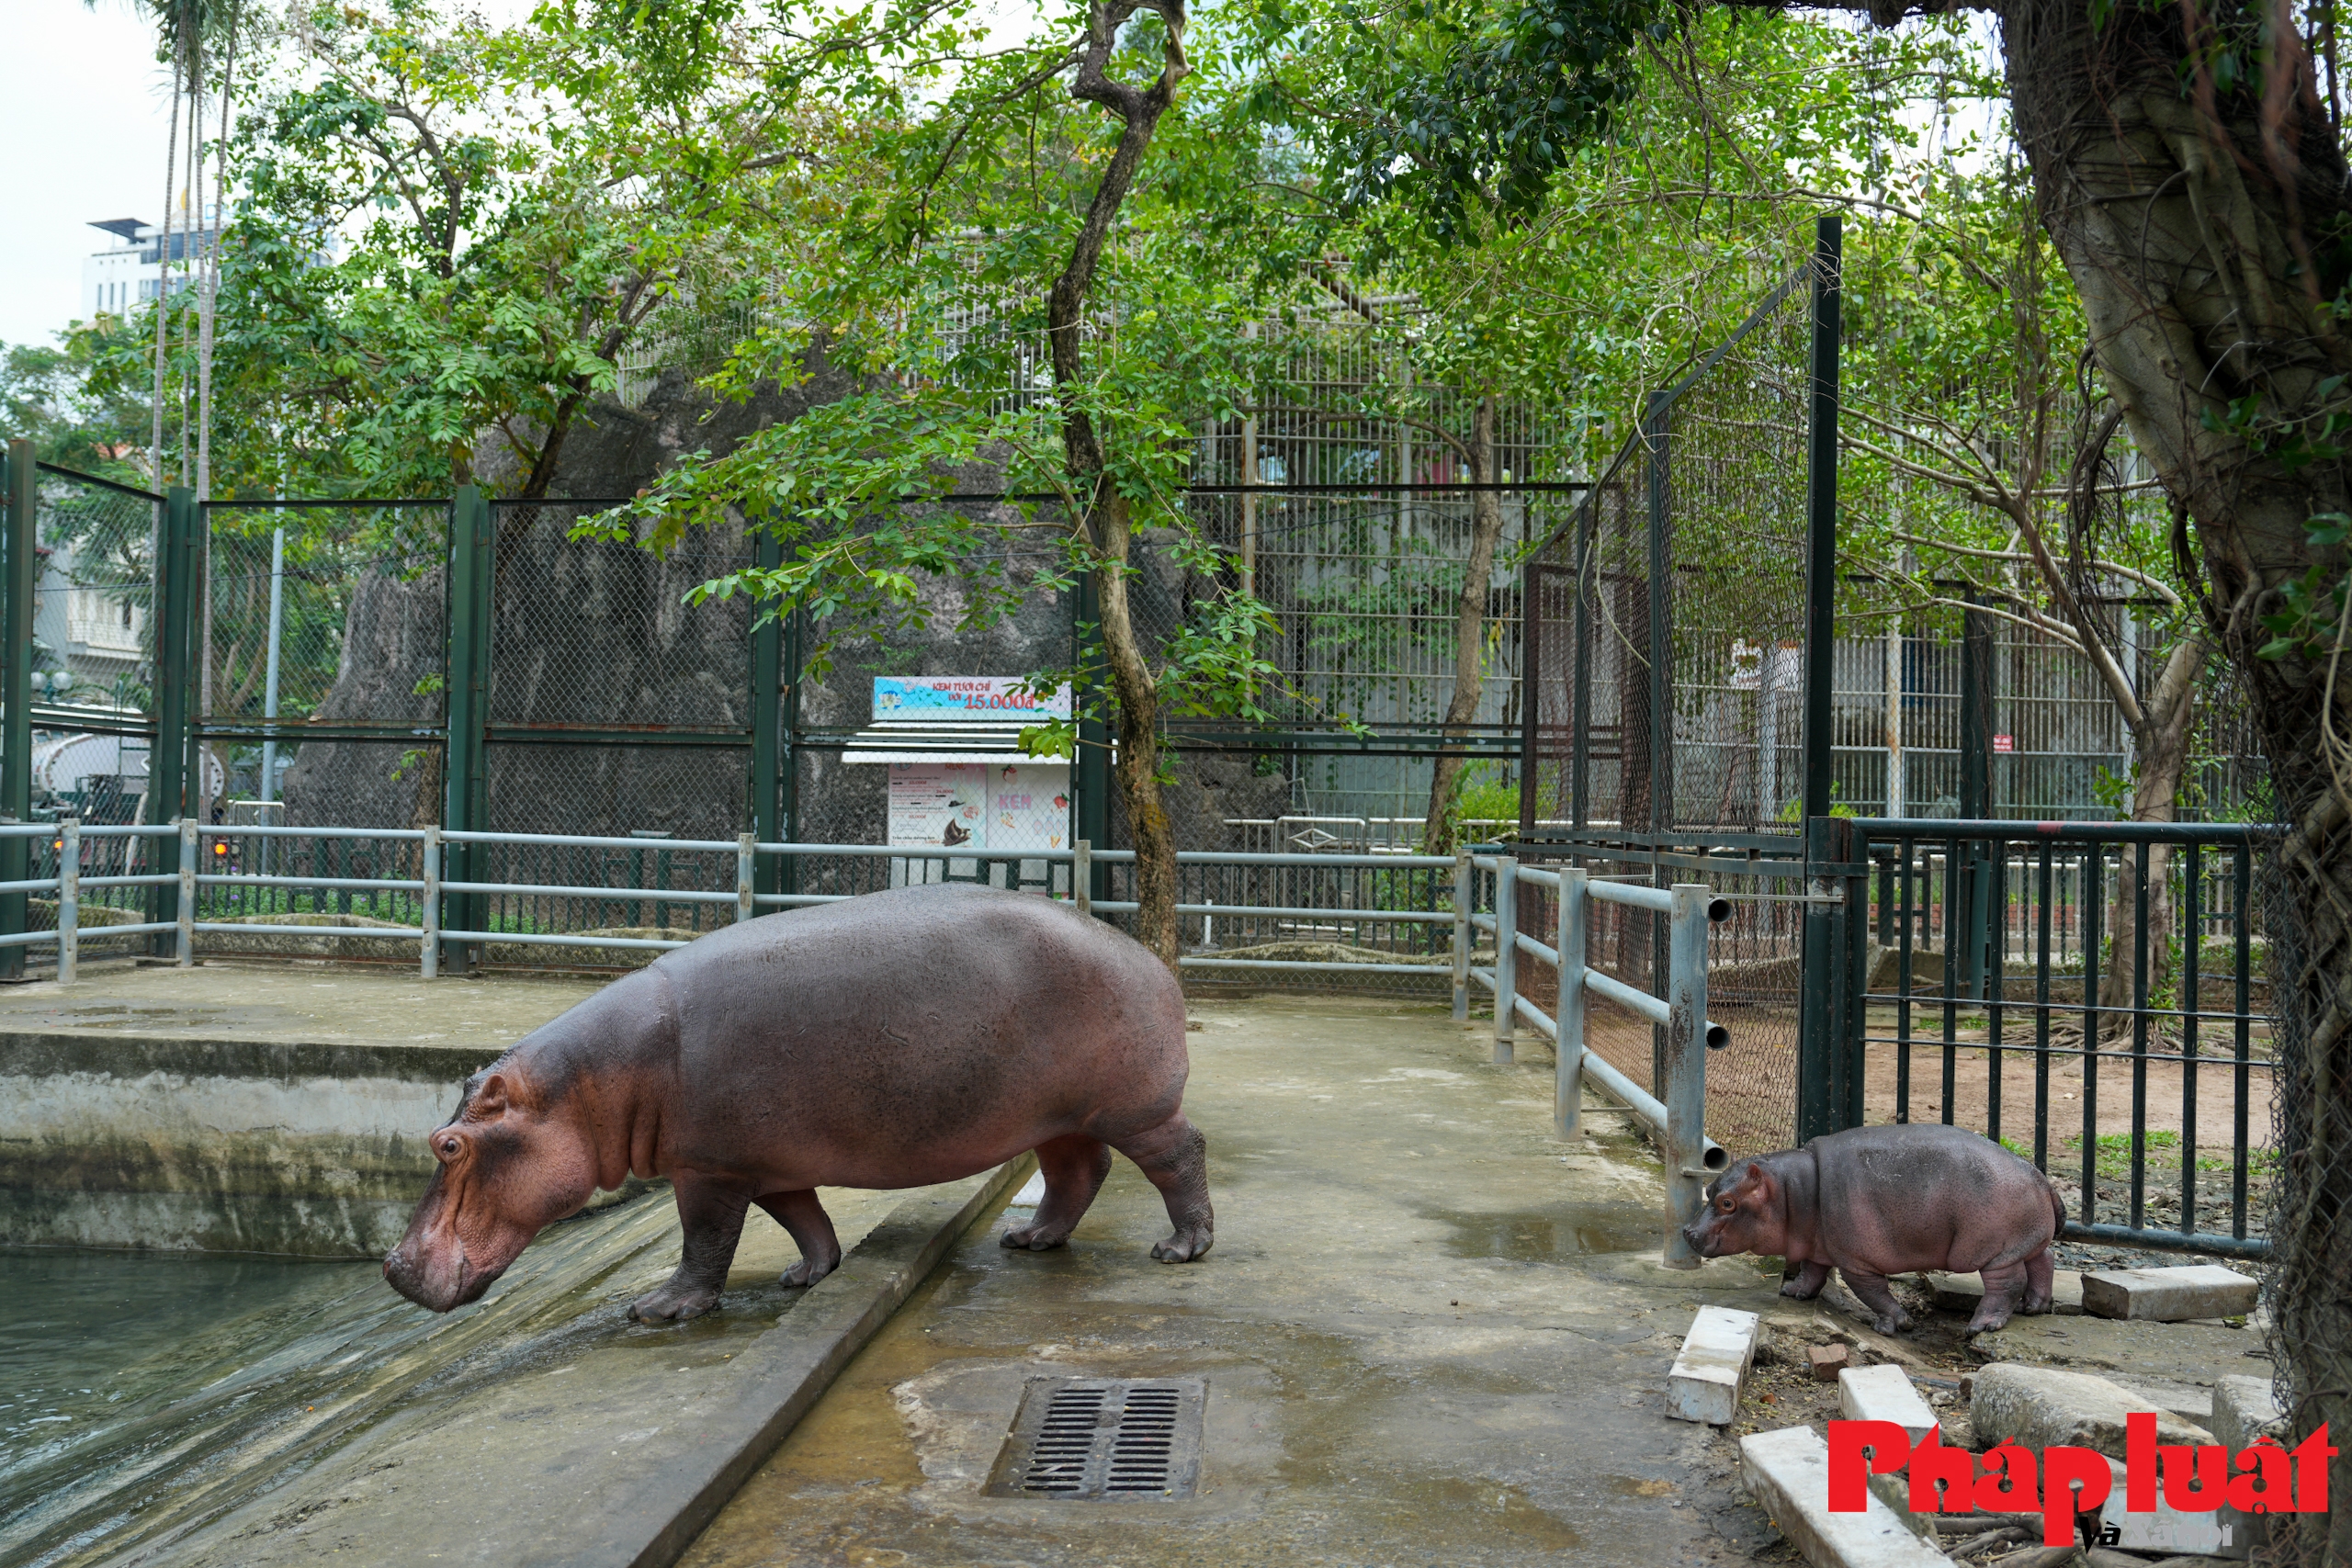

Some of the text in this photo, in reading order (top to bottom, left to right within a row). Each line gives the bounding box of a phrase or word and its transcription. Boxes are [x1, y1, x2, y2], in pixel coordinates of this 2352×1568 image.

[933, 680, 991, 692] KEM TƯƠI CHỈ
[964, 693, 1035, 710] 15.000đ
[999, 794, 1032, 810] KEM
[1033, 815, 1068, 835] DÂU
